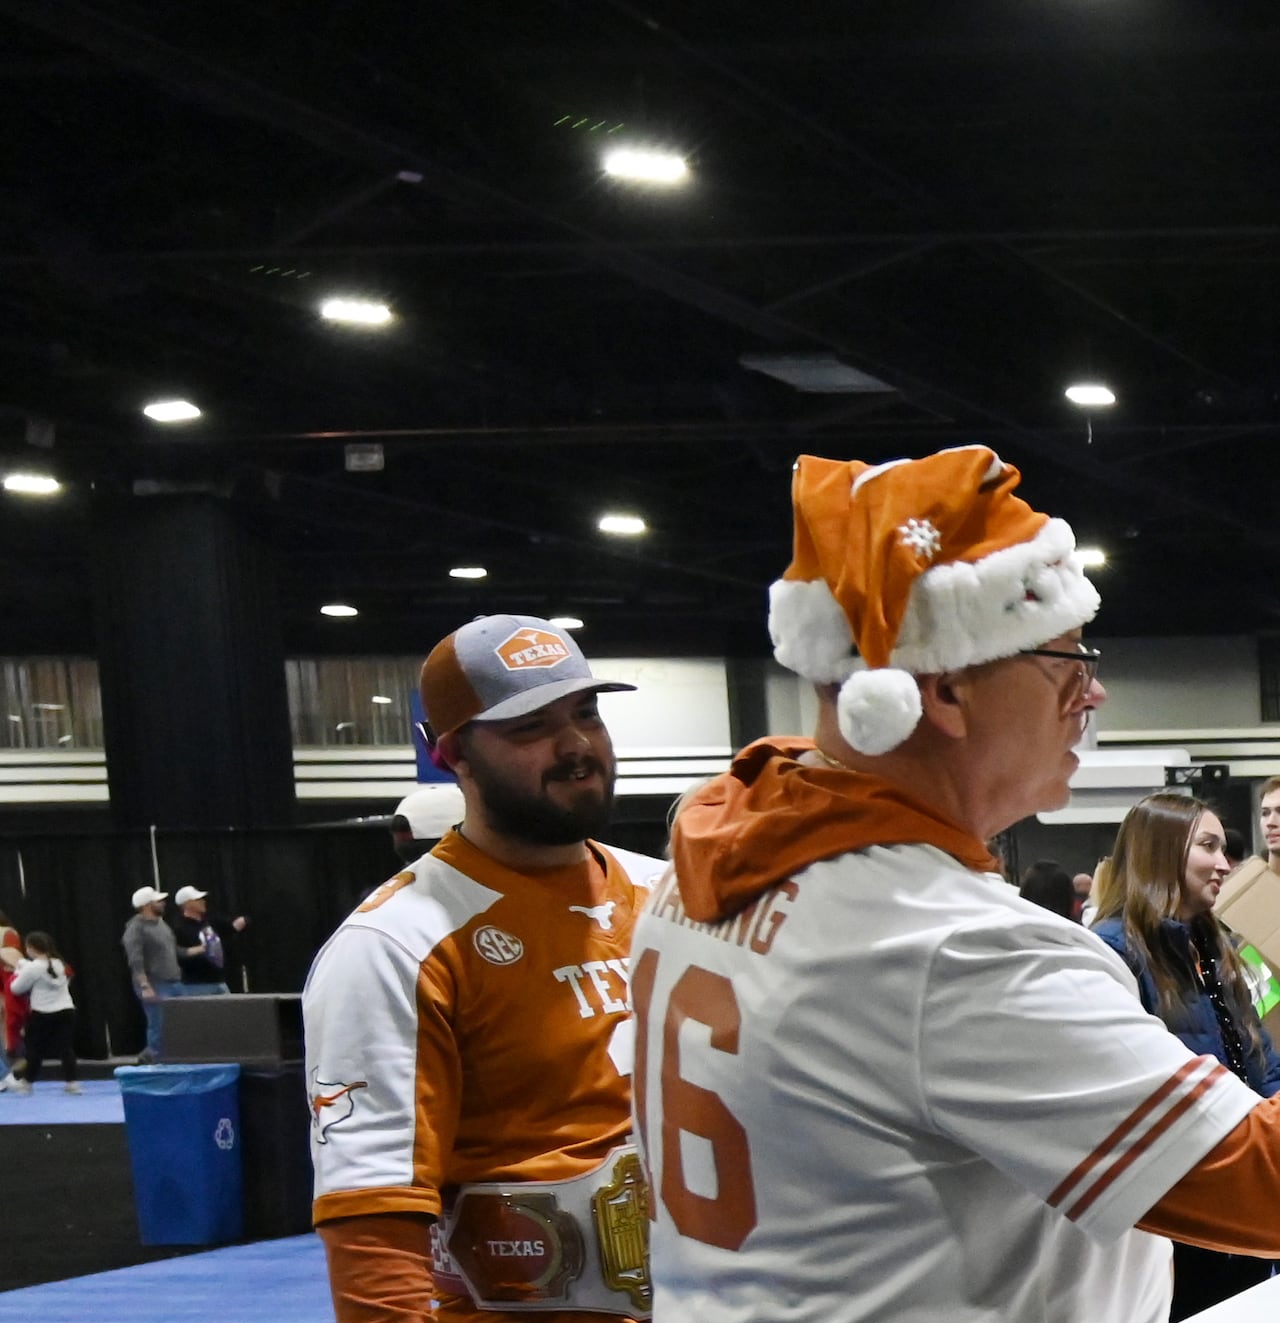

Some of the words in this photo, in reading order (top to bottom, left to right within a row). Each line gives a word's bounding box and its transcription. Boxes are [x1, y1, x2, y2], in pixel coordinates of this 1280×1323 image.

[509, 643, 567, 665] TEXAS
[477, 927, 522, 963] SEC
[631, 947, 758, 1252] 16
[487, 1240, 545, 1257] TEXAS
